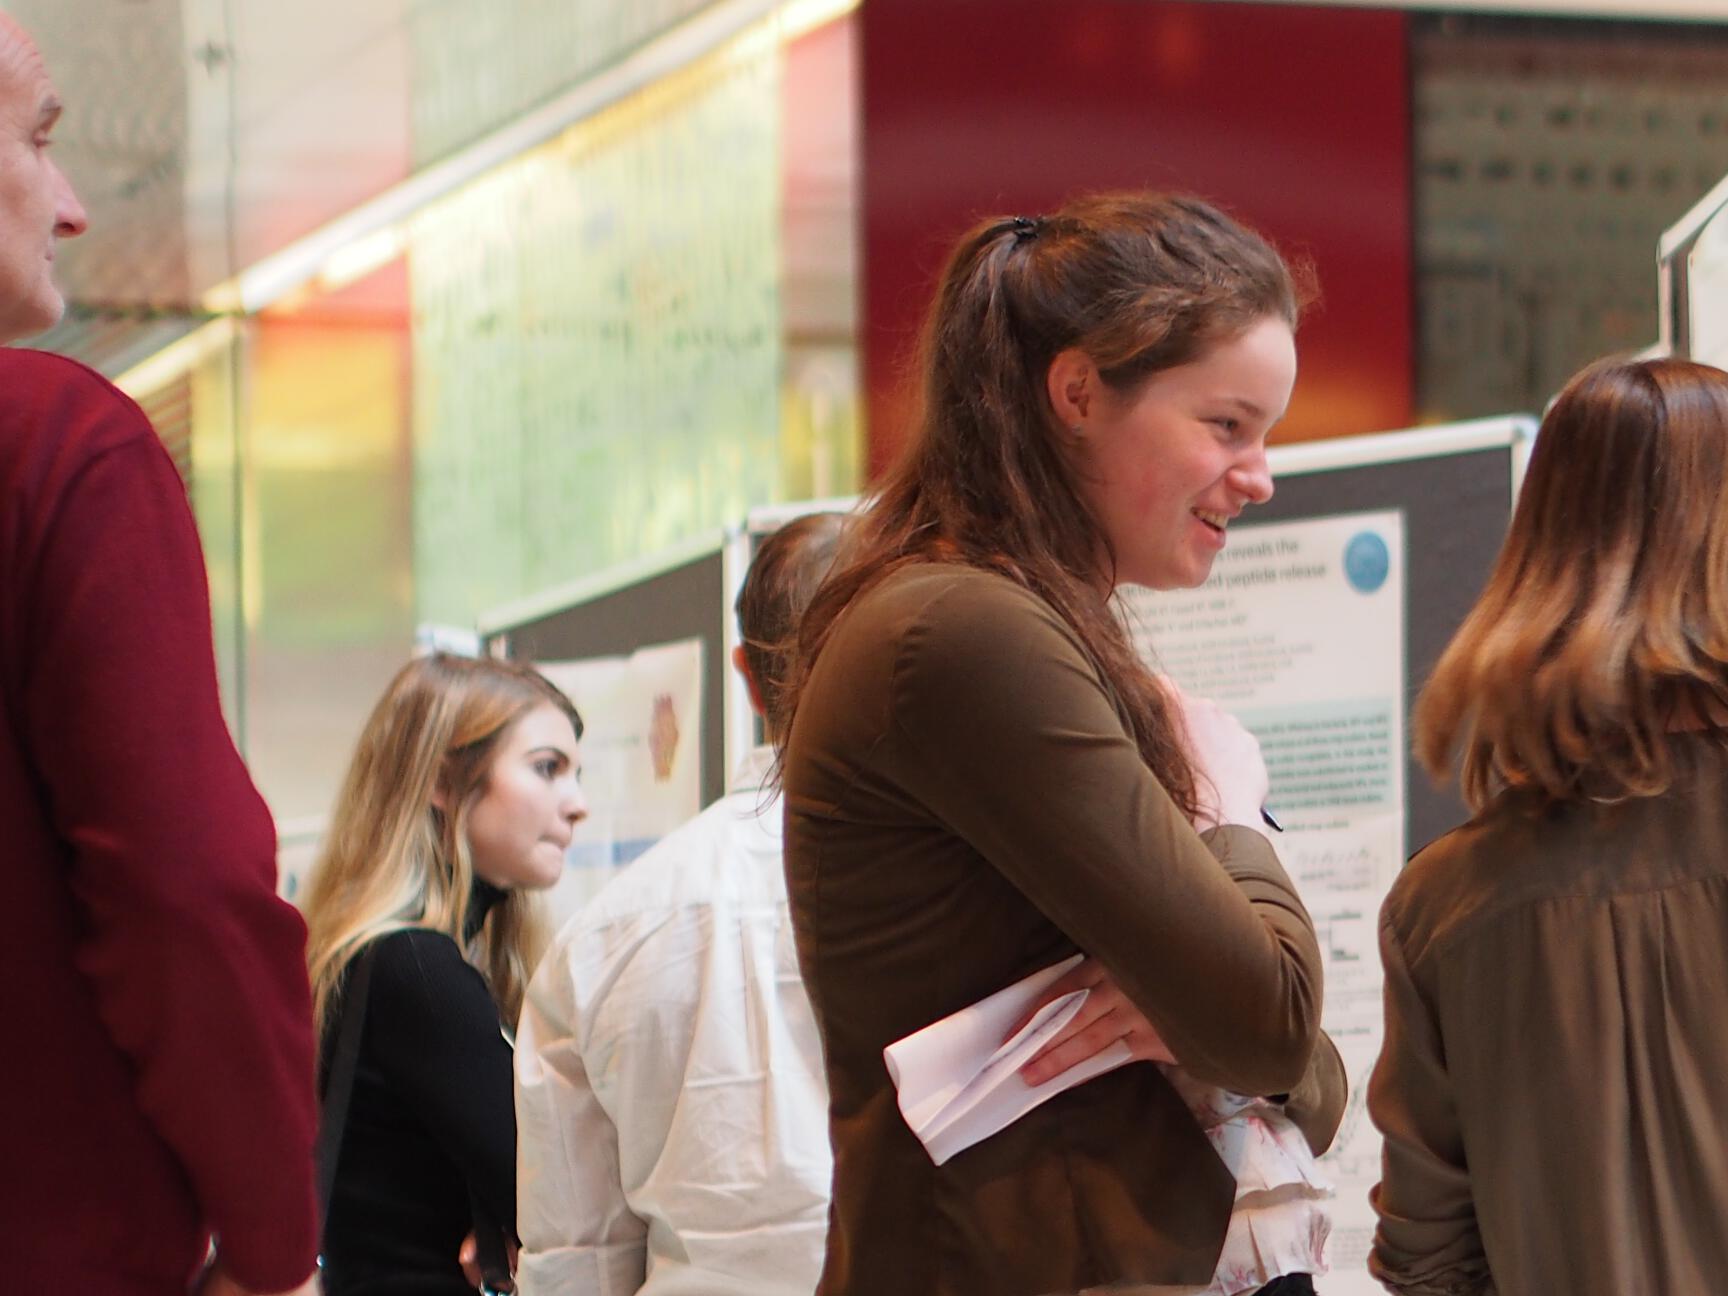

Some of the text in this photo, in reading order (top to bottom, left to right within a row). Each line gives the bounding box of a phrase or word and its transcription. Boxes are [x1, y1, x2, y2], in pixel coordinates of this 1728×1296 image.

[1226, 538, 1299, 562] reveals the
[1225, 567, 1277, 590] peptide
[1280, 564, 1326, 580] release
